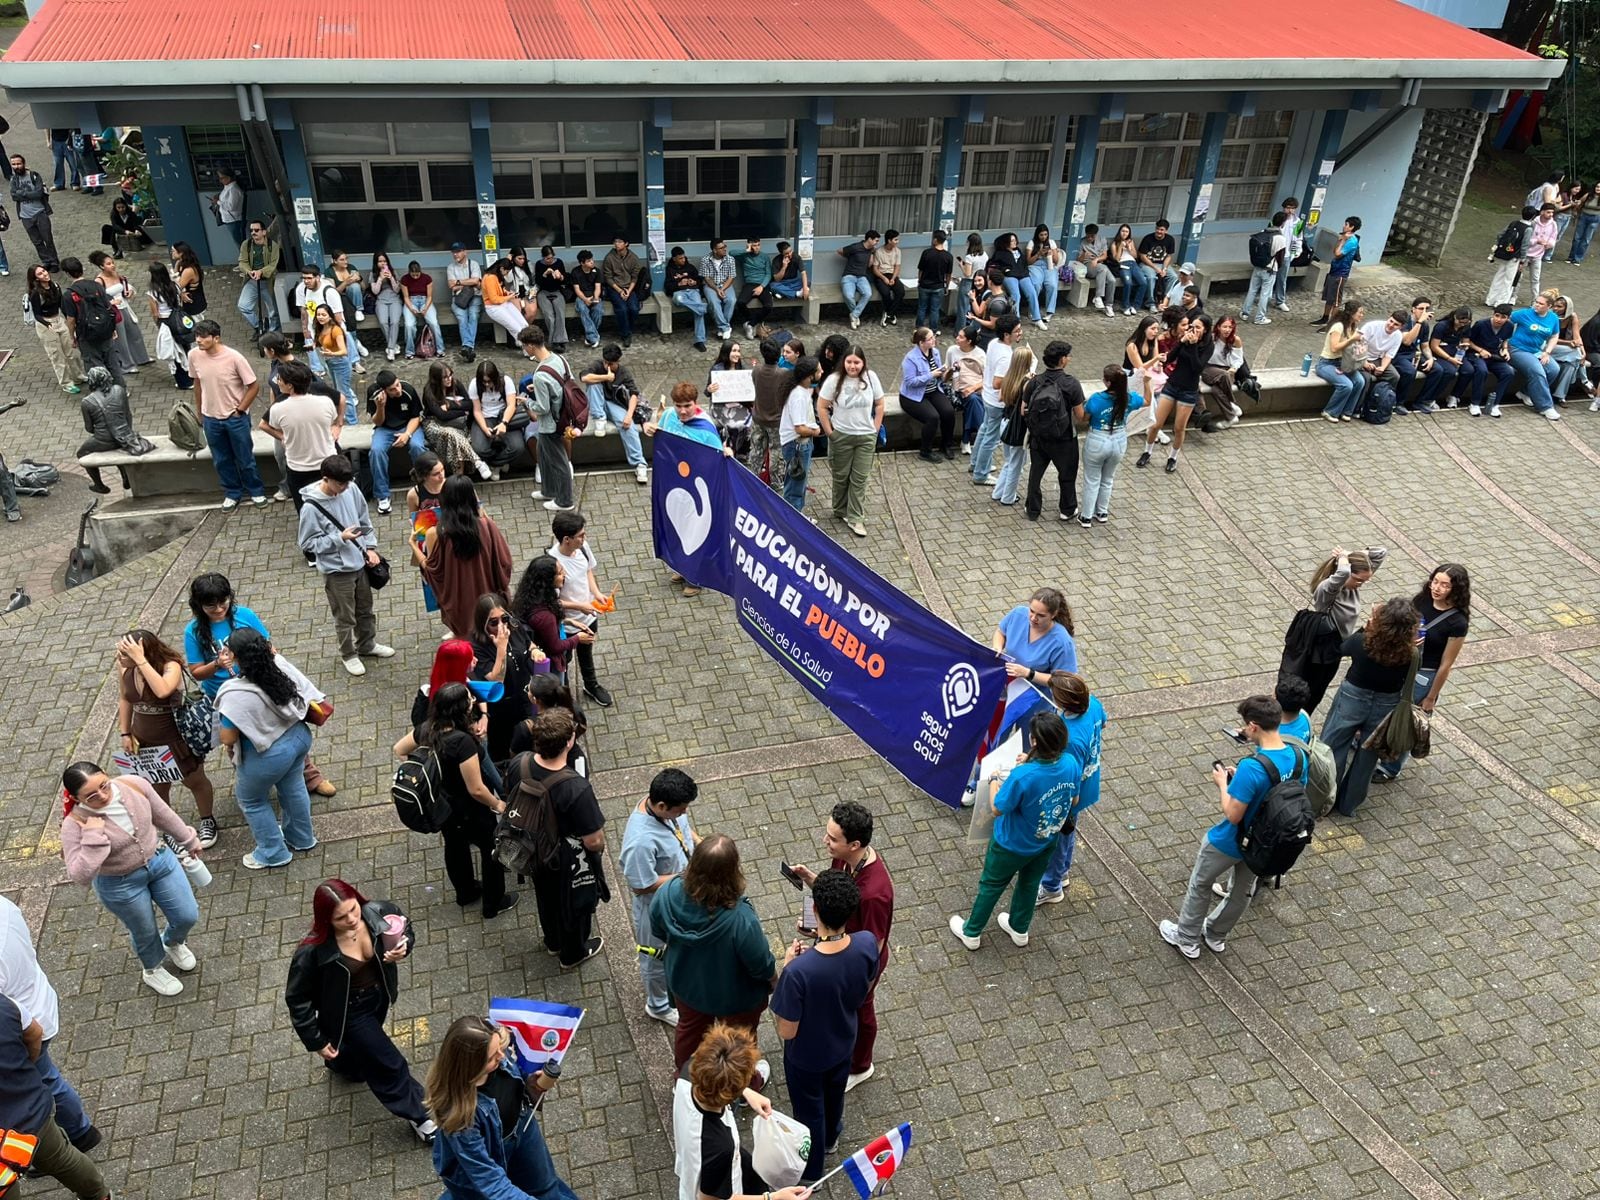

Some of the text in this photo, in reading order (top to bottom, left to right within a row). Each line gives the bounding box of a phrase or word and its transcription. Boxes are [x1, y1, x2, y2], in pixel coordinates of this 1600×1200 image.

[735, 506, 891, 640] EDUCACIÓN POR
[735, 544, 778, 599] PARA
[779, 583, 803, 619] EL
[804, 603, 886, 679] PUEBLO
[741, 597, 834, 683] Ciencias de la Salud
[913, 740, 942, 765] aquí
[919, 729, 945, 752] mos
[920, 711, 953, 740] segui
